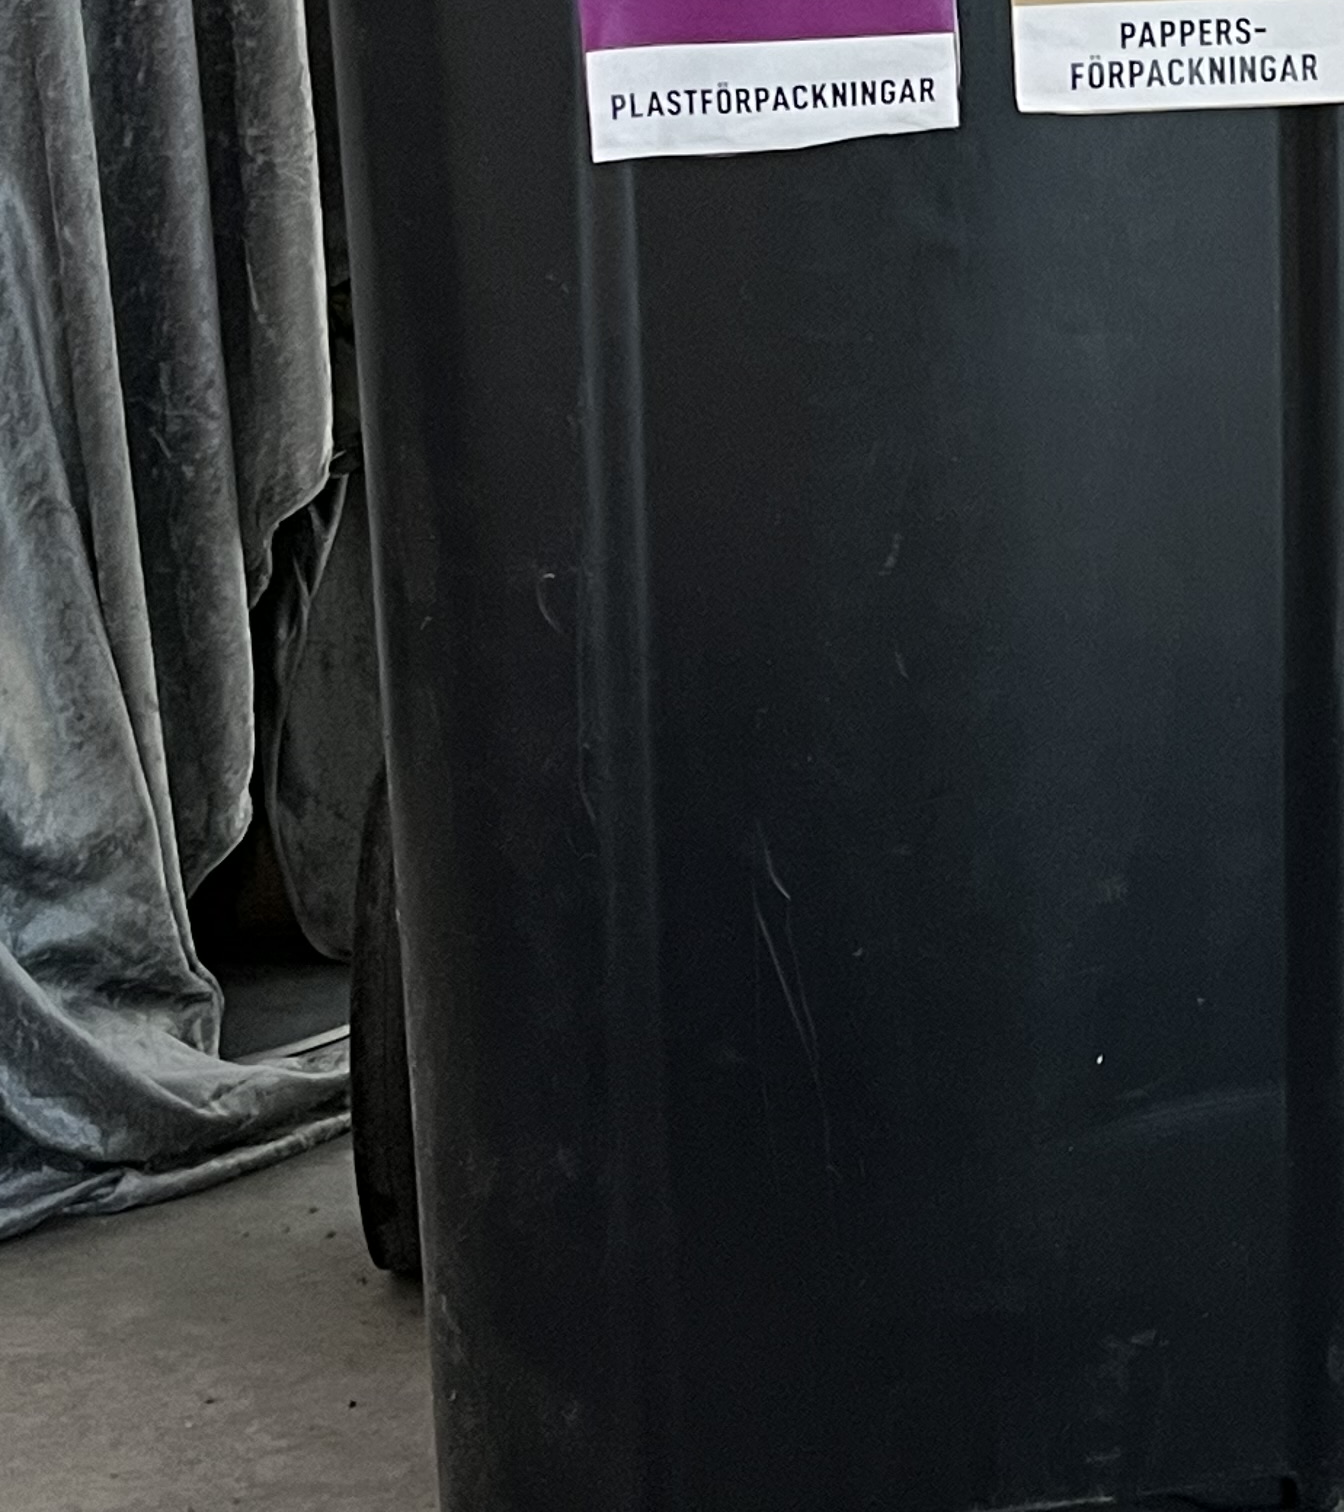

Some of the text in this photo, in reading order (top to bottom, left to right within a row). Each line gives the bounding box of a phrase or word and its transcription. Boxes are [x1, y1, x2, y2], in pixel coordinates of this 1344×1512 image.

[1121, 18, 1267, 48] PAPPERS-
[1070, 54, 1318, 90] FÖRPACKNINGAR
[611, 77, 936, 120] PLASTFÖRPACKNINGAR
